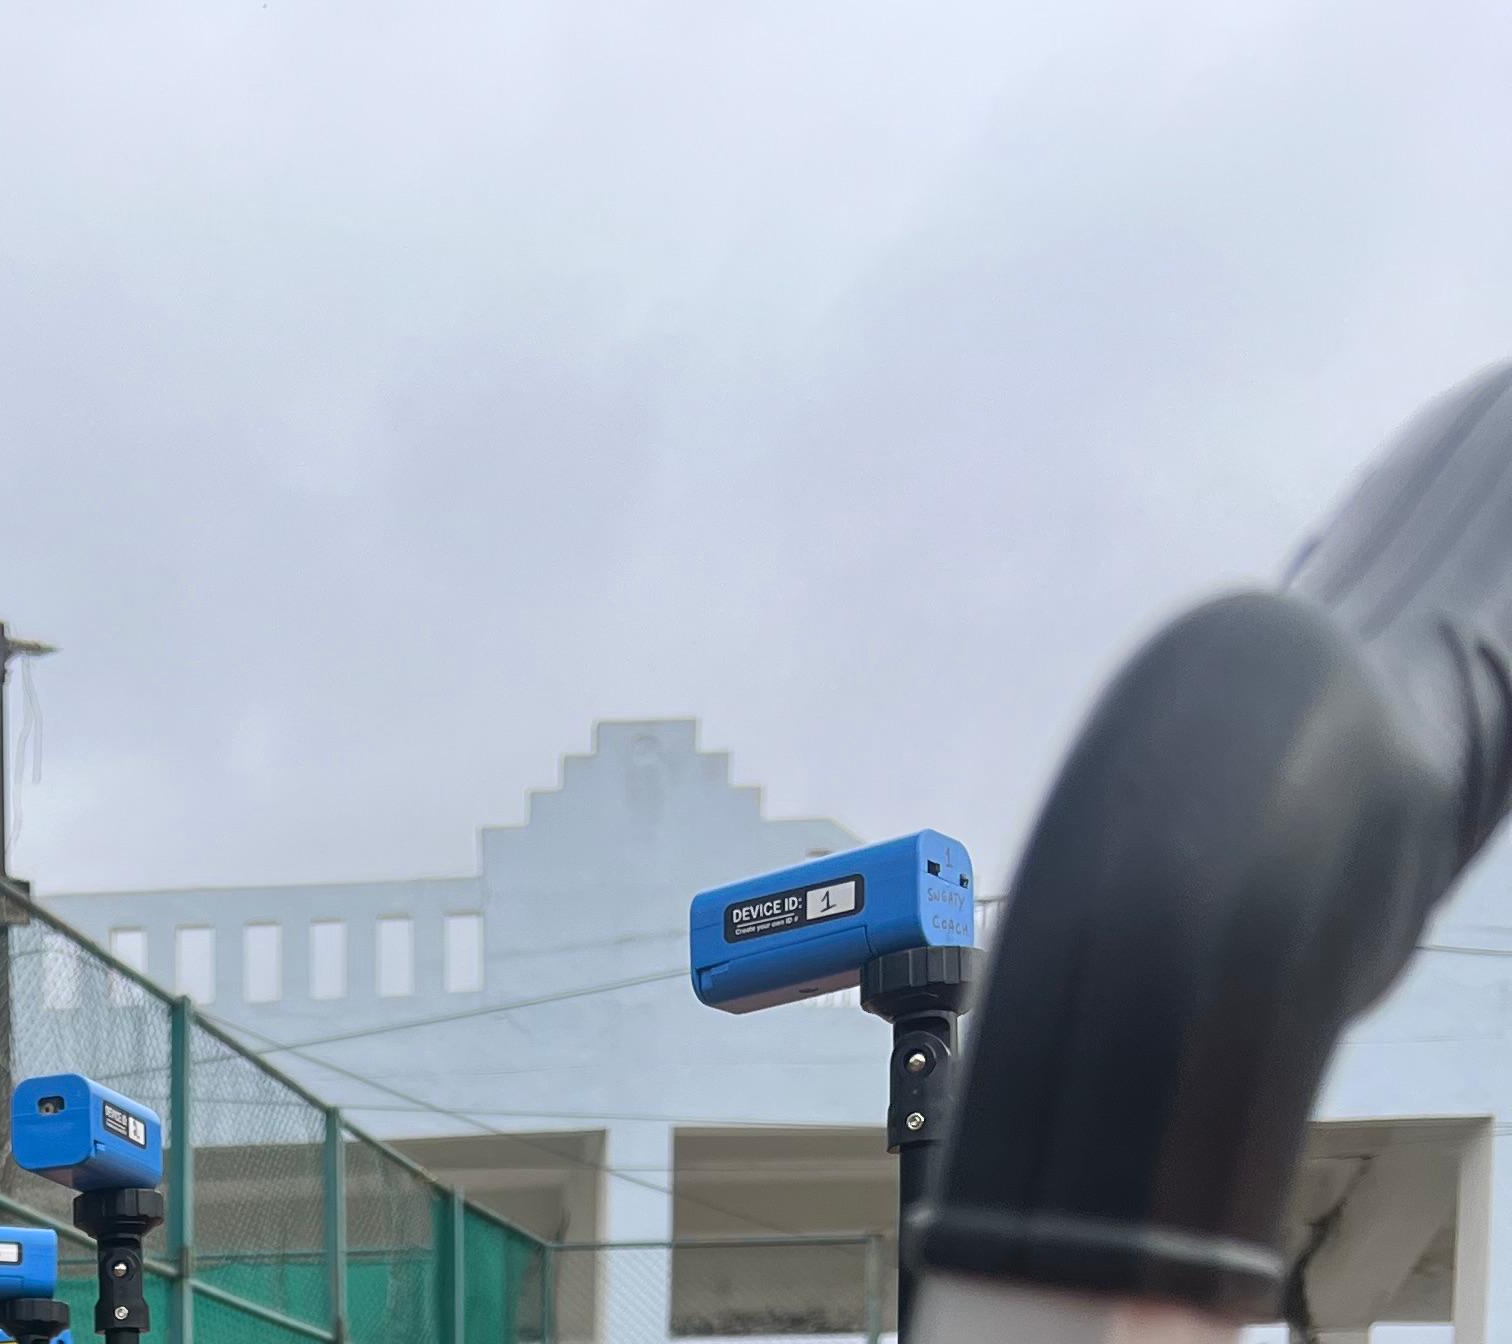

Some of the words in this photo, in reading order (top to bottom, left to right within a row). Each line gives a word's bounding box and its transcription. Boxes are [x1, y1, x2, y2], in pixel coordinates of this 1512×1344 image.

[732, 900, 782, 923] DEVICE
[784, 896, 803, 912] ID:
[820, 890, 837, 913] 1
[756, 922, 771, 932] your
